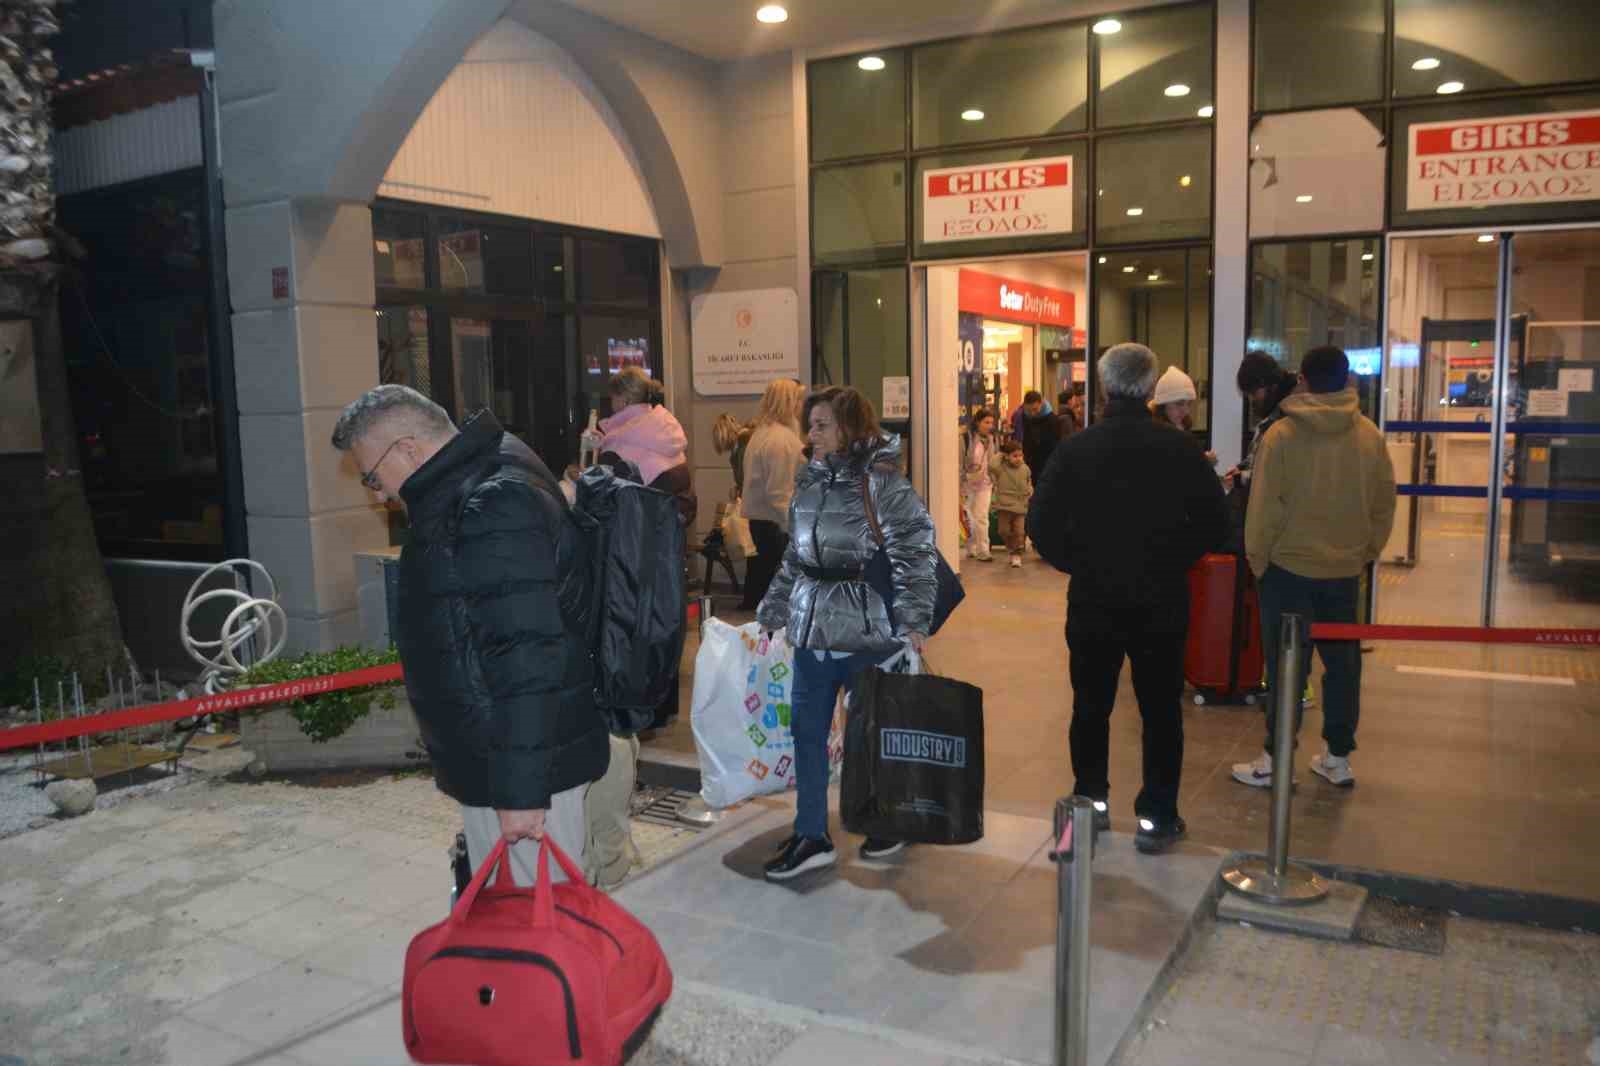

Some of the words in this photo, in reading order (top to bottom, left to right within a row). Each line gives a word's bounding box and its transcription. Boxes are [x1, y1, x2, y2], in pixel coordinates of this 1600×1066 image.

[1418, 150, 1600, 179] ENTRANCE
[969, 194, 1025, 214] EXIT
[886, 733, 953, 761] INDUSTRY
